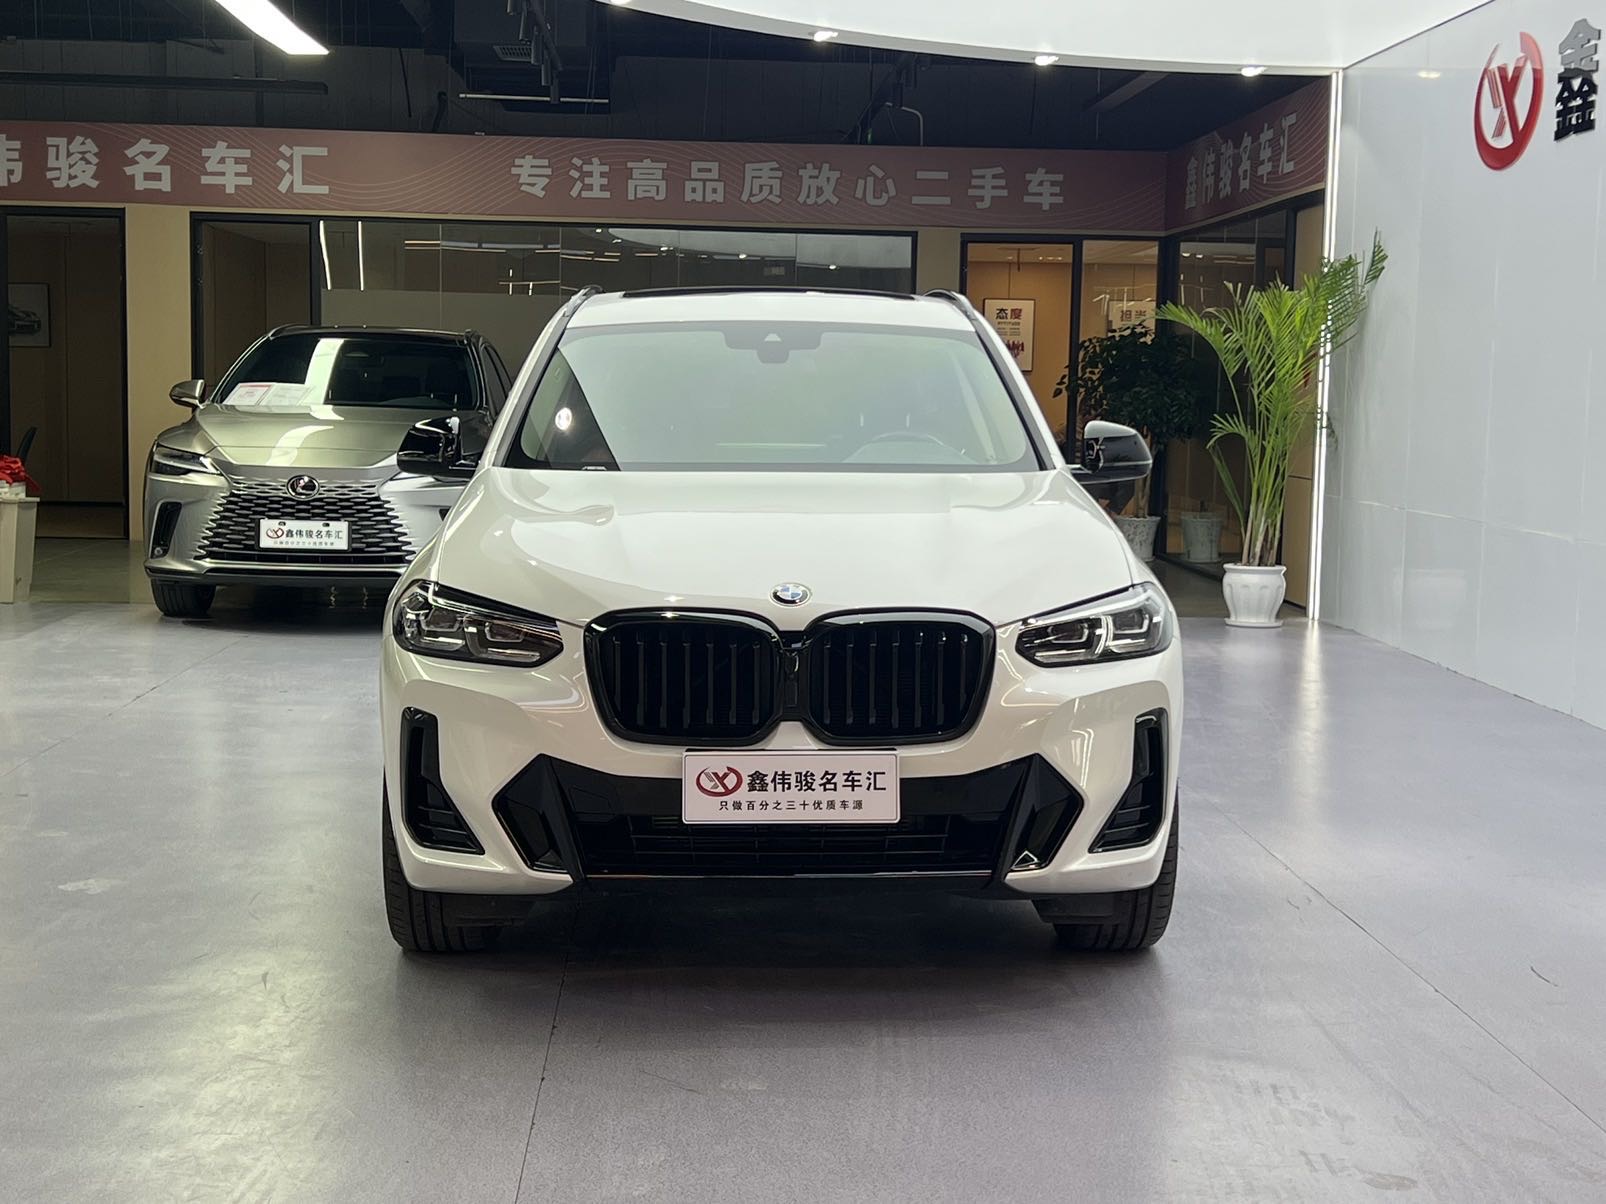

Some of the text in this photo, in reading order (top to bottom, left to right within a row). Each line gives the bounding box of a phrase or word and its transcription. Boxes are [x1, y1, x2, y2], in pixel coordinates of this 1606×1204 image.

[1554, 18, 1601, 141] 鑫
[1185, 113, 1297, 209] 鑫伟骏名车汇
[511, 154, 1064, 210] 专注高品质放心二手车
[995, 307, 1022, 320] 态度
[285, 529, 343, 540] 鑫伟骏名车汇
[746, 770, 886, 792] 鑫伟骏名车汇
[718, 800, 864, 811] 只做百分之三十优质车源
